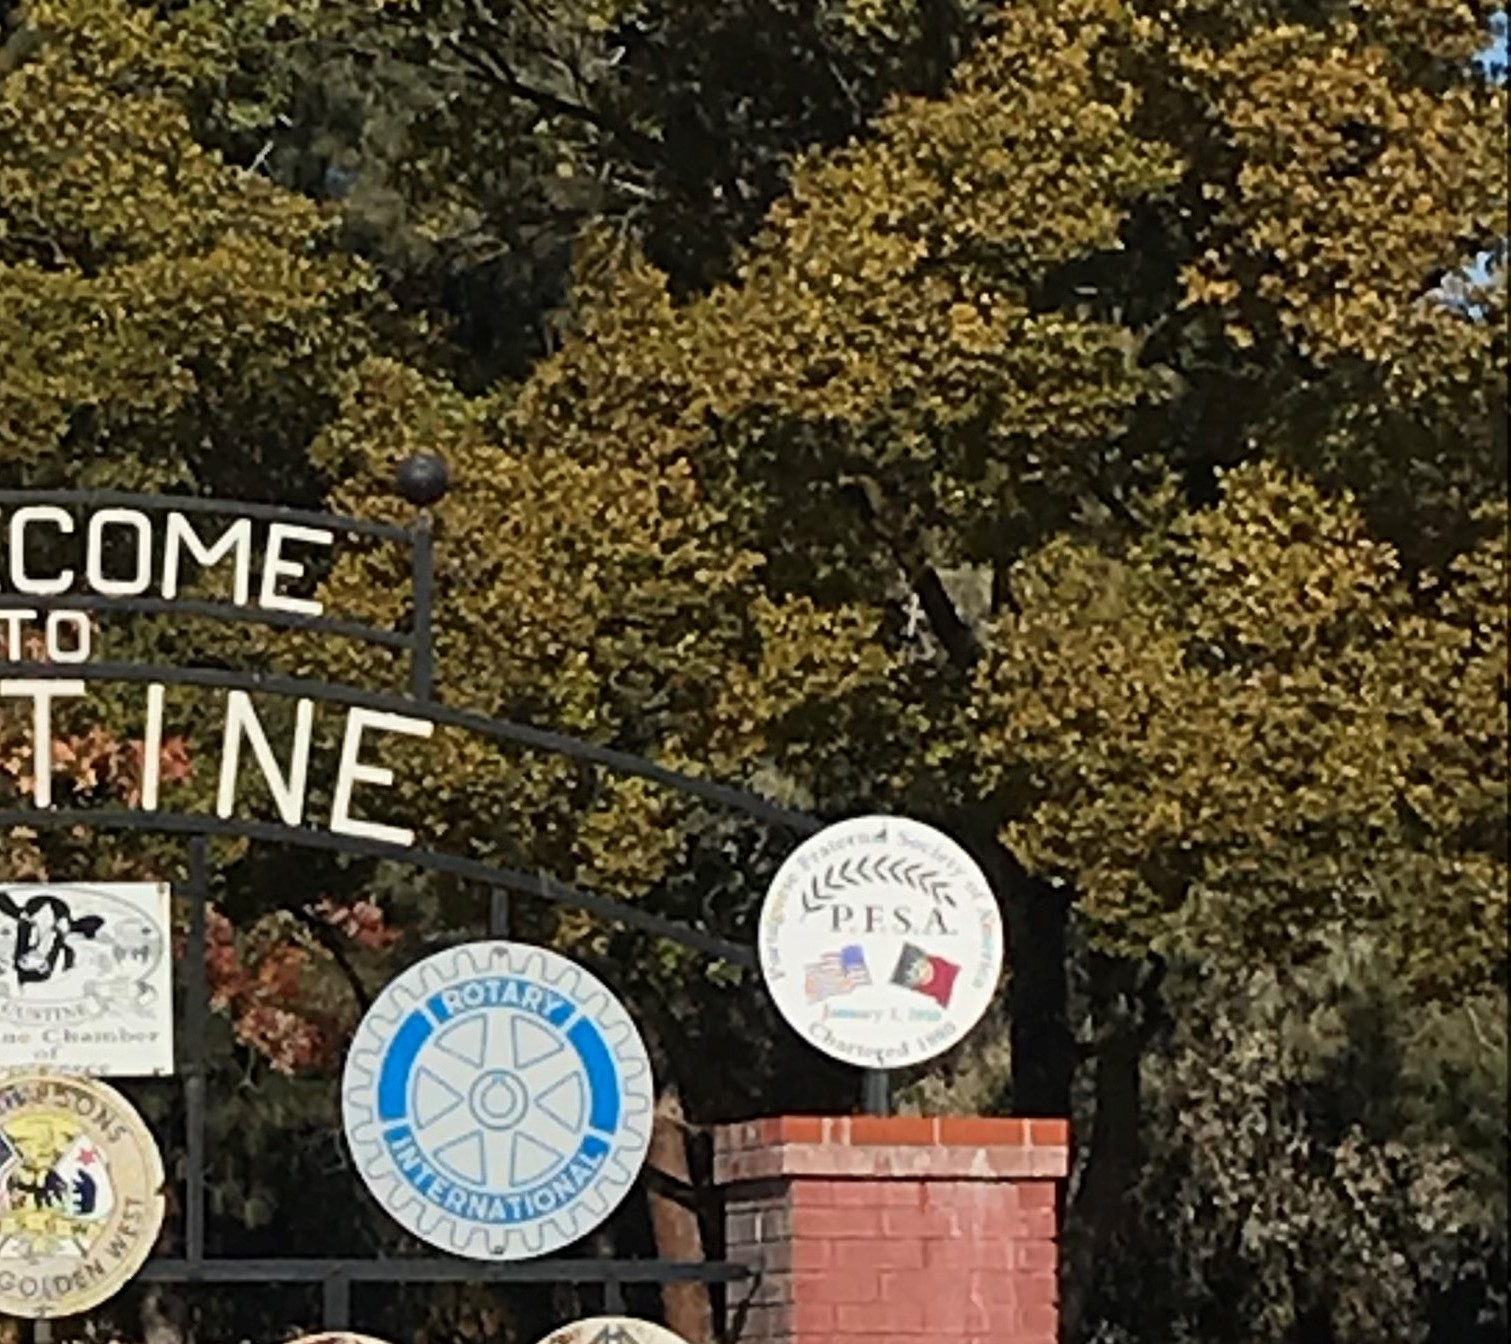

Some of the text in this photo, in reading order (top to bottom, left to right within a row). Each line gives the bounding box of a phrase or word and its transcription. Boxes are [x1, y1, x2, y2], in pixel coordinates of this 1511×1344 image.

[831, 905, 960, 936] P.F.S.A.
[441, 980, 564, 1016] ROTARY
[32, 1047, 60, 1060] of
[41, 1028, 160, 1045] Chamber
[807, 1020, 910, 1059] Chartered
[49, 1083, 128, 1143] SONS
[390, 1138, 605, 1221] INTERNATIONAL
[105, 1196, 144, 1258] WEST
